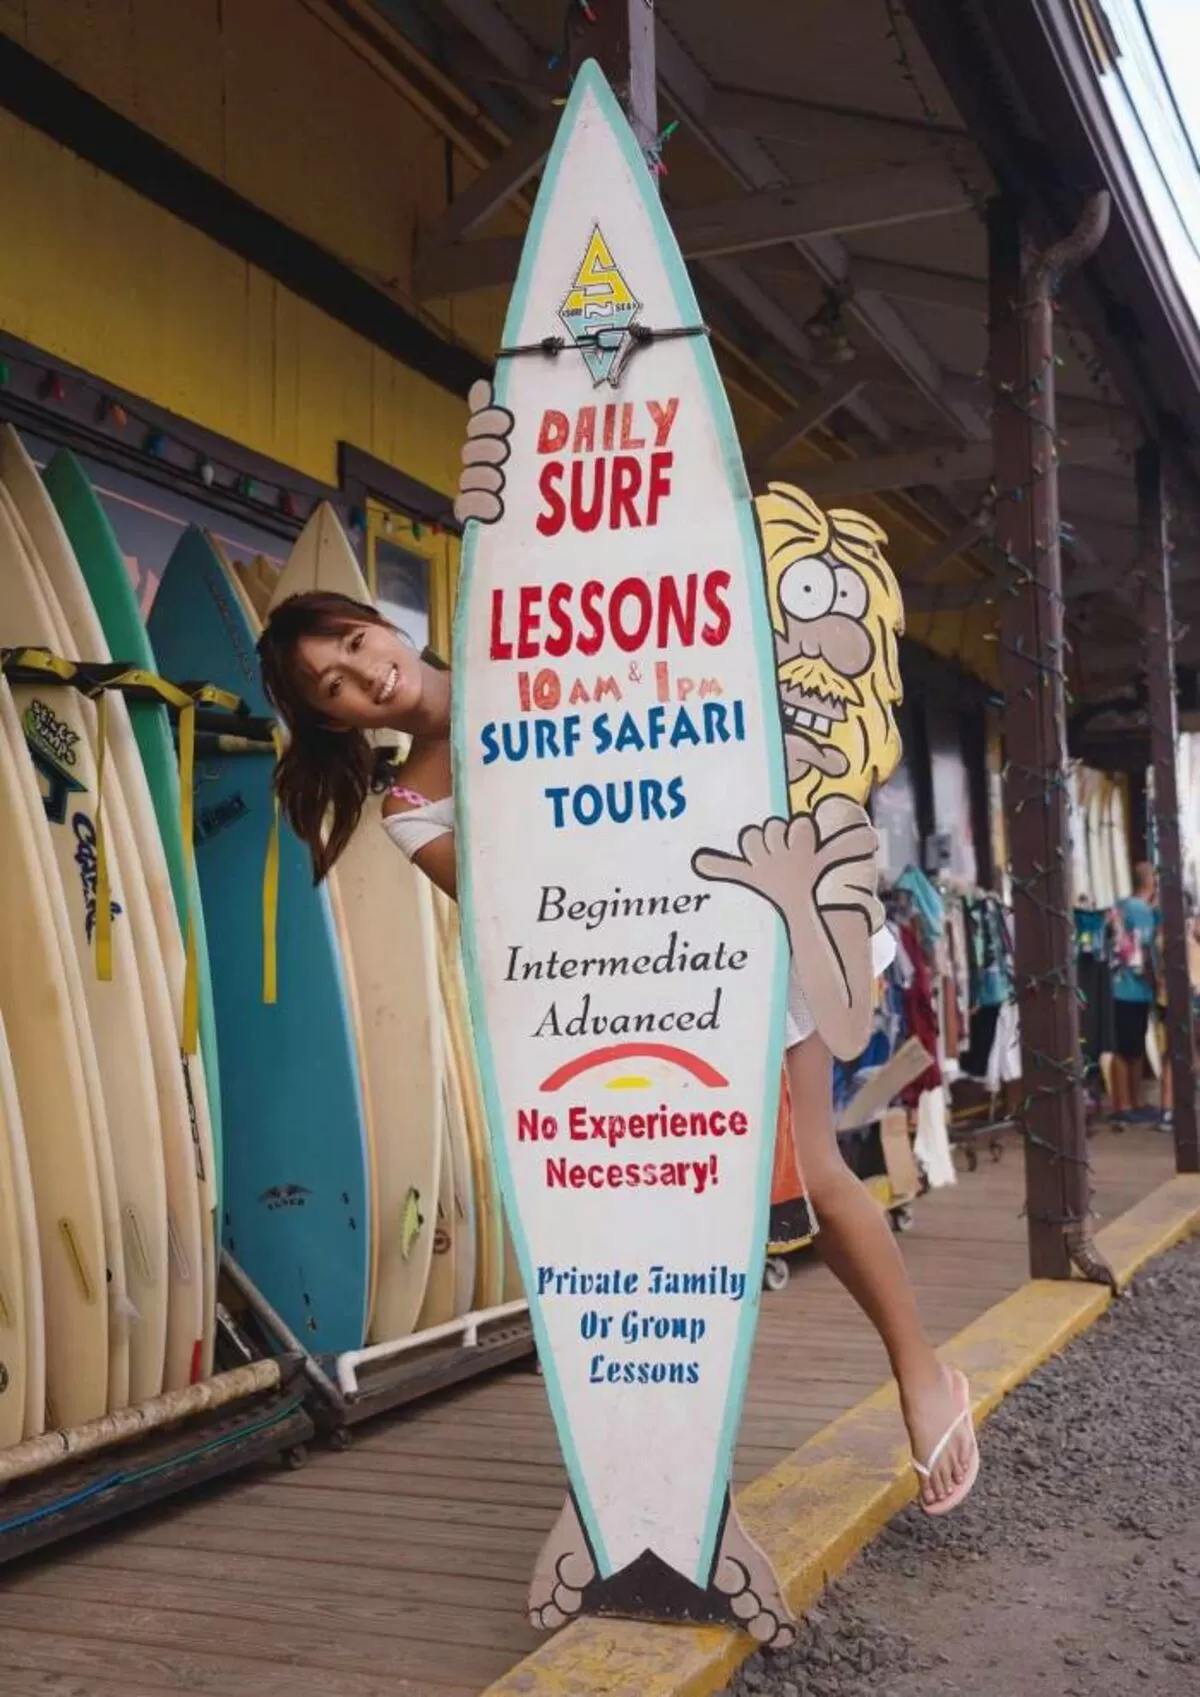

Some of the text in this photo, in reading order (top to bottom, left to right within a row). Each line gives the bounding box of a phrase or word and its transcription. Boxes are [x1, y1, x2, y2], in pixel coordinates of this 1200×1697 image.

[536, 397, 679, 455] DAILY
[536, 451, 674, 537] SURF
[489, 569, 732, 661] LESSONS
[627, 659, 642, 684] &
[480, 699, 746, 765] SURF SAFARI
[544, 775, 687, 829] TOURS
[536, 884, 711, 931] Beginner
[503, 930, 749, 982] Intermediate
[530, 986, 723, 1038] Advanced
[517, 1103, 749, 1148] No Experience
[545, 1154, 719, 1194] Necessary!
[536, 1265, 747, 1301] Private Family
[580, 1310, 706, 1344] Or Group
[589, 1354, 700, 1384] Lessons
